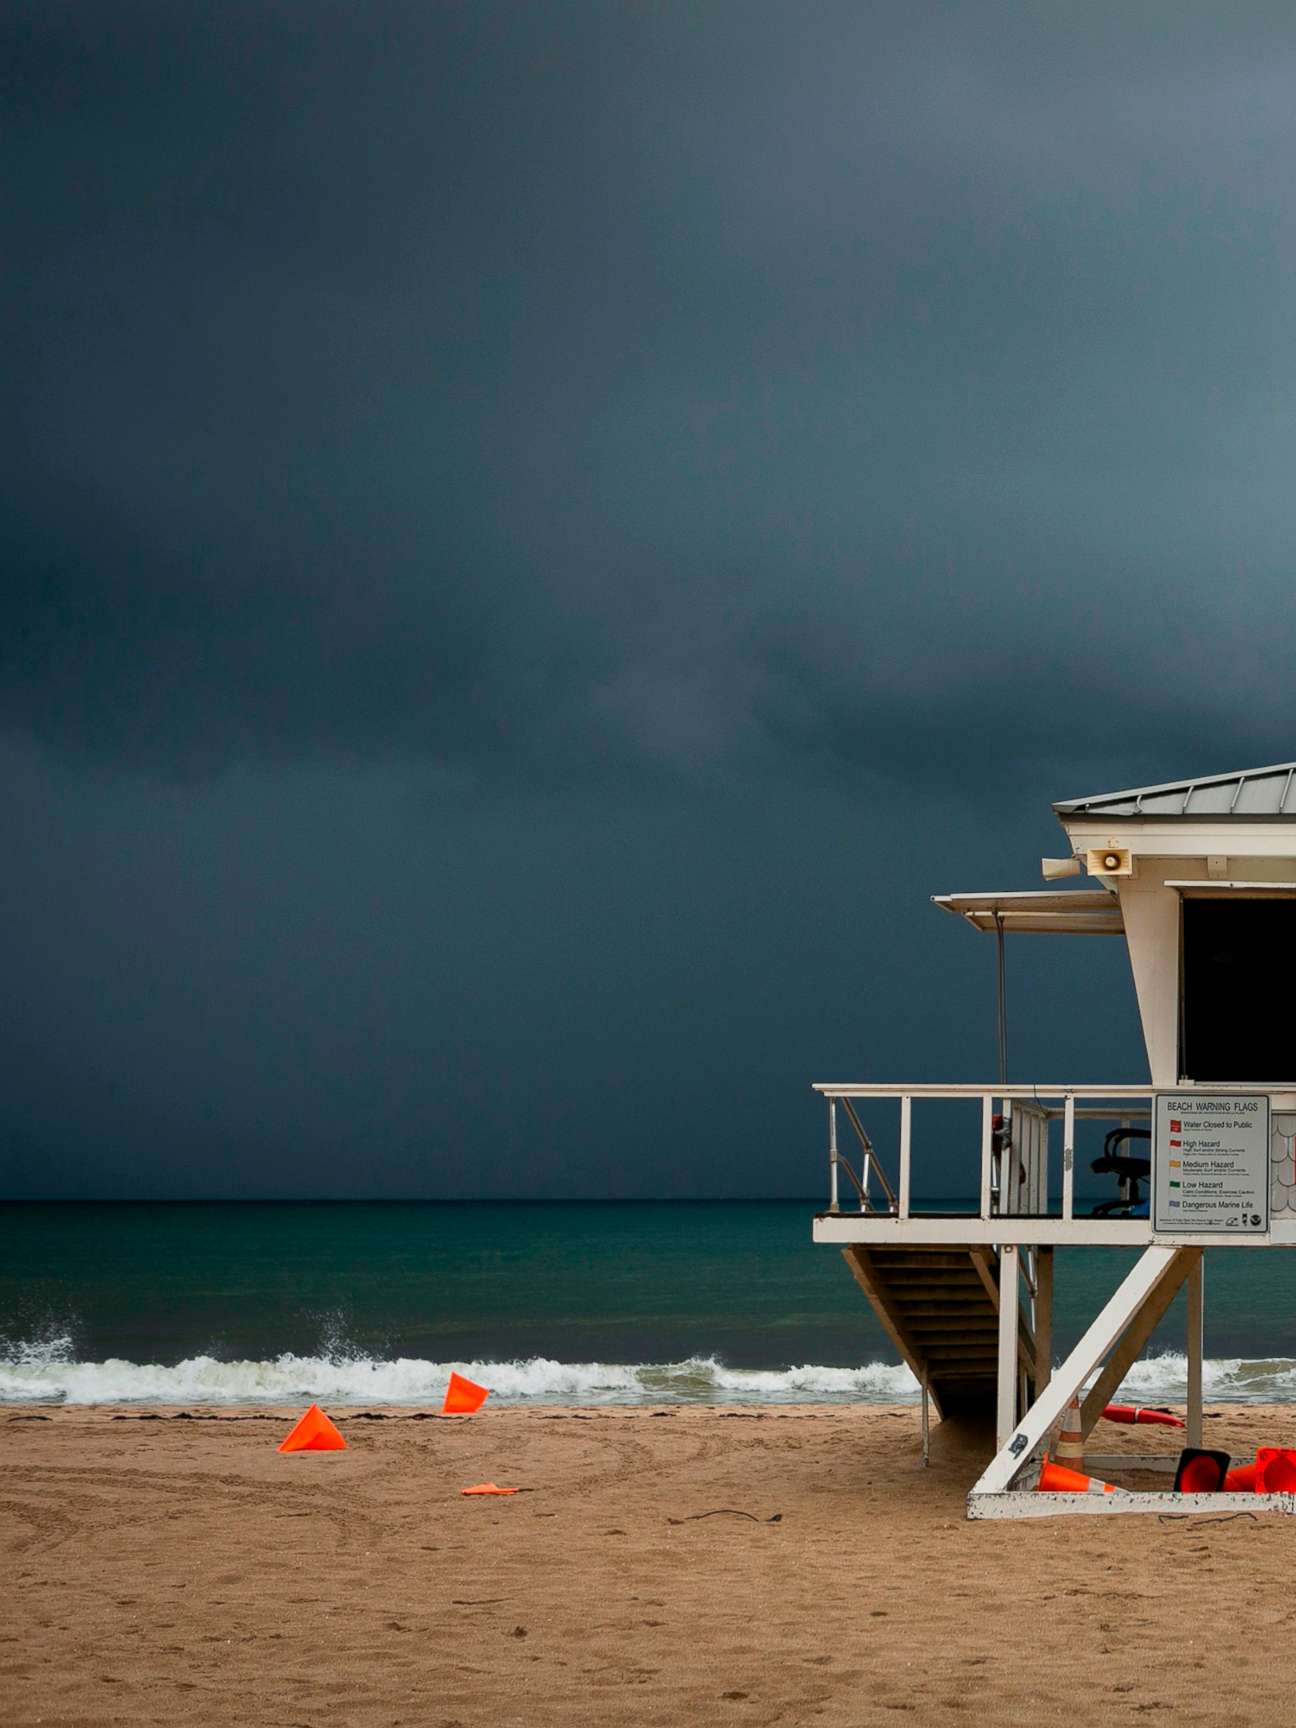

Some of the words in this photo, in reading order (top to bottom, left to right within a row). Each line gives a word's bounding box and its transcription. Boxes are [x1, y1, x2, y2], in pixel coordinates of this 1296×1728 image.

[1167, 1102, 1193, 1111] BEACH
[1196, 1102, 1231, 1111] WARNING
[1234, 1102, 1258, 1112] FLAGS
[1183, 1121, 1202, 1129] Water
[1203, 1120, 1225, 1129] Closed
[1233, 1120, 1253, 1129] Public
[1183, 1140, 1197, 1149] High
[1198, 1140, 1221, 1148] Hazard
[1182, 1201, 1217, 1209] Dangerous
[1218, 1201, 1240, 1209] Marine
[1241, 1201, 1254, 1209] Life
